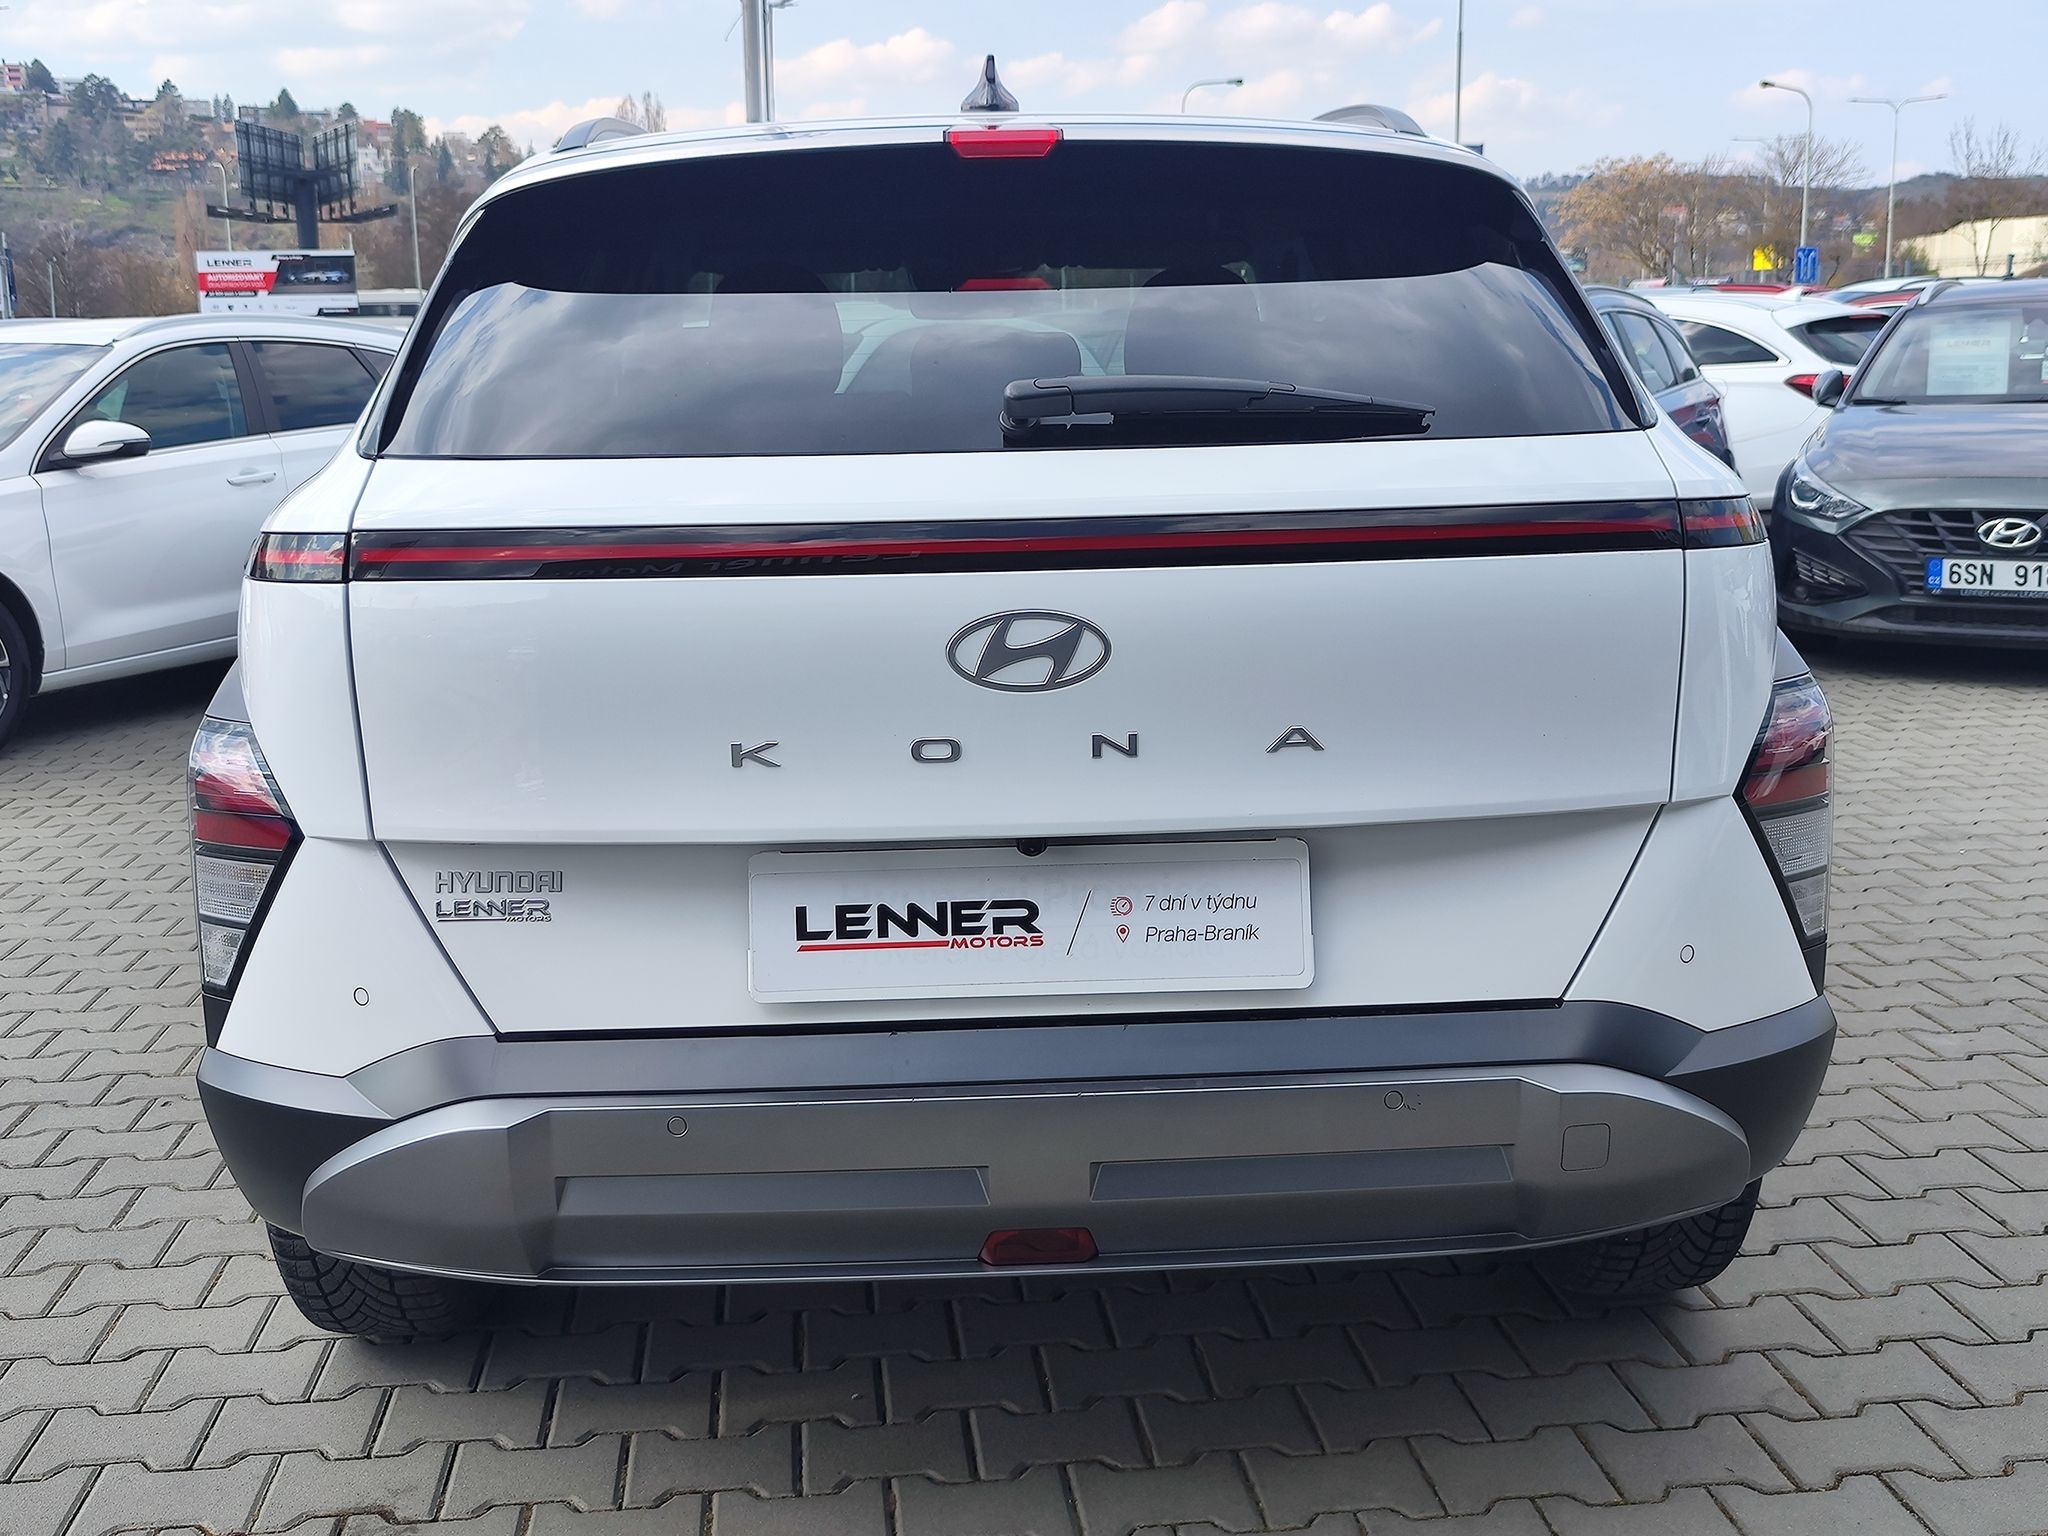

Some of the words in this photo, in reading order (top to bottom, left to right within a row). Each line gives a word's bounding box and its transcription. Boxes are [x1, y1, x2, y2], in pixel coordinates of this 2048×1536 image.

[206, 259, 253, 267] LENNER
[1949, 563, 1994, 586] 6SN
[2014, 565, 2048, 587] 91
[435, 870, 563, 893] HYUNDAI
[435, 898, 551, 918] LENNER
[1145, 895, 1156, 912] 7
[1160, 893, 1187, 912] dní
[1190, 897, 1202, 911] v
[1206, 893, 1257, 914] týdnu
[505, 915, 552, 923] MOTORS
[795, 898, 1043, 942] LENNER
[949, 934, 1044, 950] MOTORS
[1145, 923, 1260, 943] Praha-Braník
